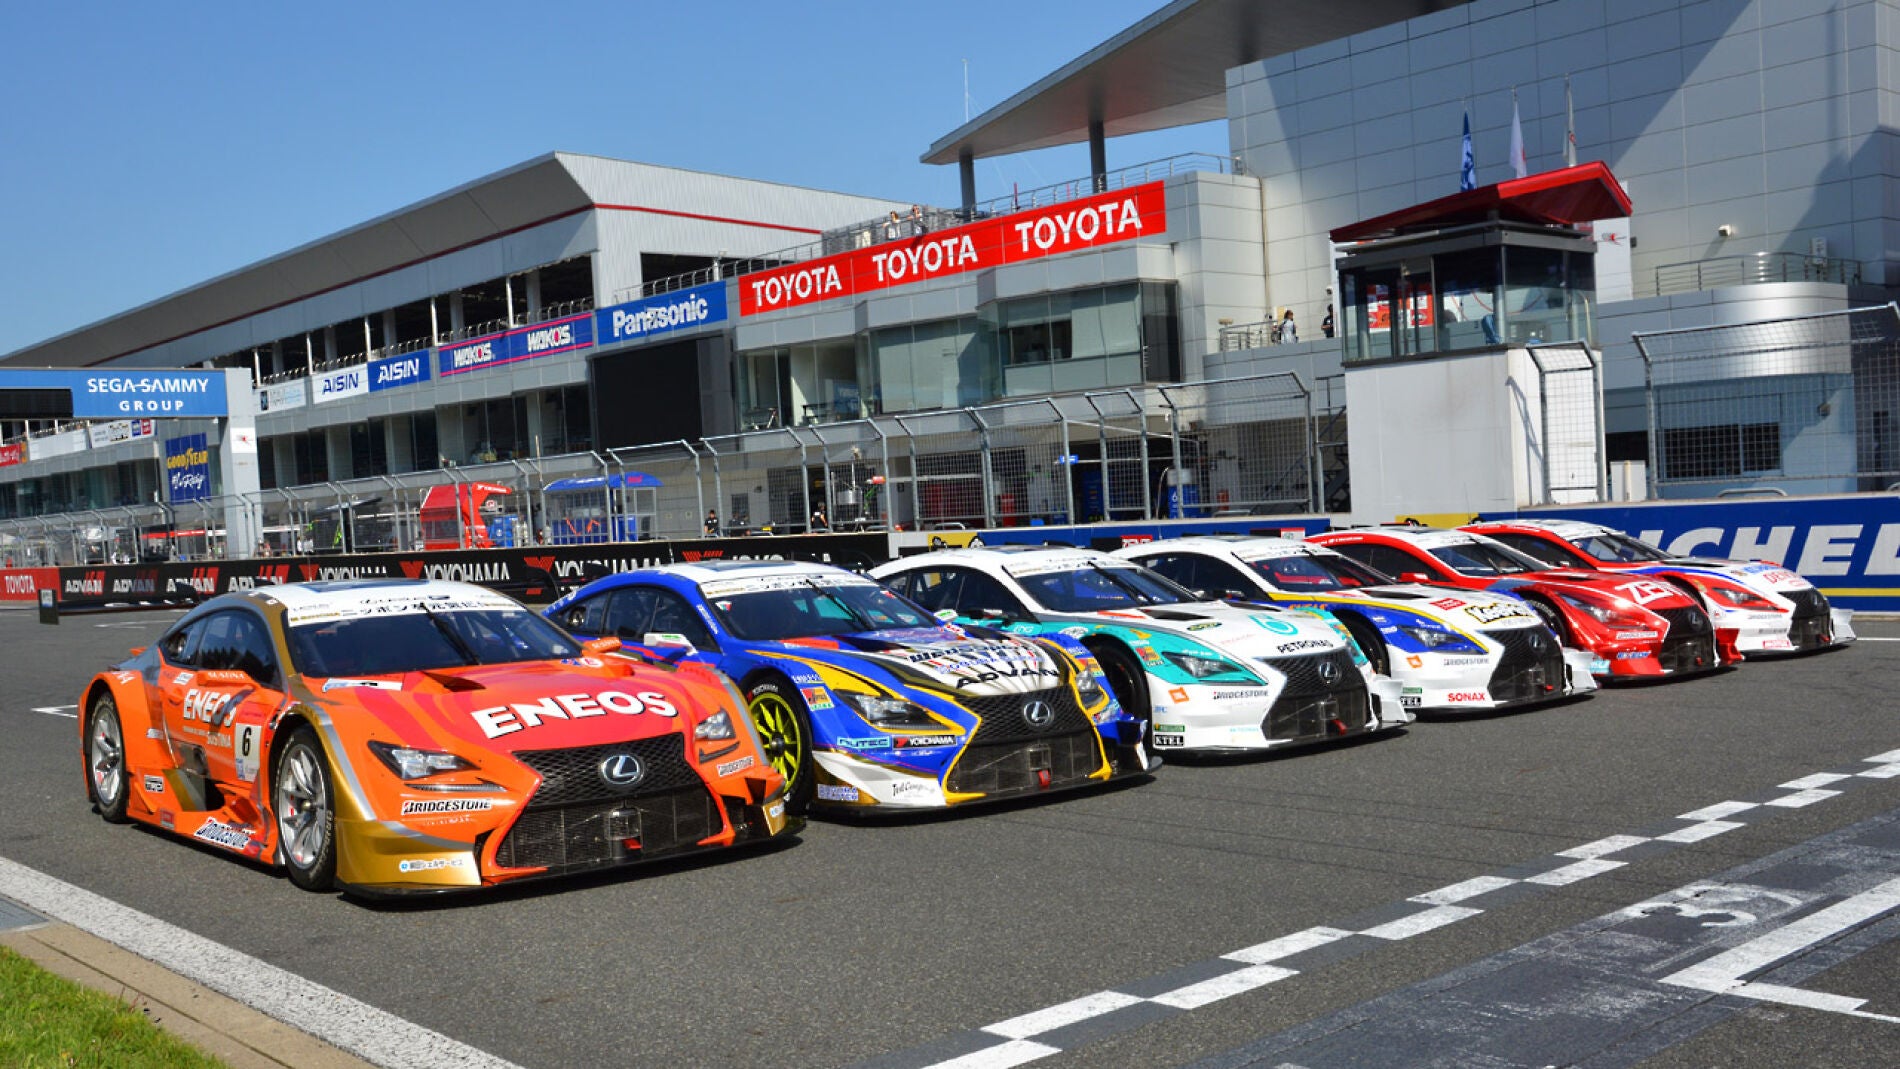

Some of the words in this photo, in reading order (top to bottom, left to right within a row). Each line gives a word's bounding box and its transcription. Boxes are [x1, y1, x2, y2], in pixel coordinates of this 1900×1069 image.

[1014, 198, 1142, 253] TOYOTA
[872, 235, 978, 283] TOYOTA
[752, 264, 842, 308] TOYOTA
[612, 294, 708, 338] Panasonic
[377, 358, 420, 384] AISIN
[322, 372, 359, 395] AISIN
[119, 400, 184, 411] GROUP
[318, 564, 387, 581] YOKOH
[424, 560, 510, 582] YOKOHAMA
[5, 575, 35, 594] TOYOTA
[65, 577, 104, 594] ADVAN
[113, 577, 155, 593] ADVAN
[166, 577, 215, 593] AAN
[1277, 639, 1333, 653] PETRONAS
[956, 668, 1060, 688] ADVAN
[1213, 690, 1269, 700] BRIDGESTONE
[1447, 692, 1486, 702] SONAX
[471, 692, 678, 739] ENEOS
[241, 726, 252, 756] 6
[909, 735, 955, 746] YOKOHAMA
[403, 799, 491, 813] BRIDGESTONE
